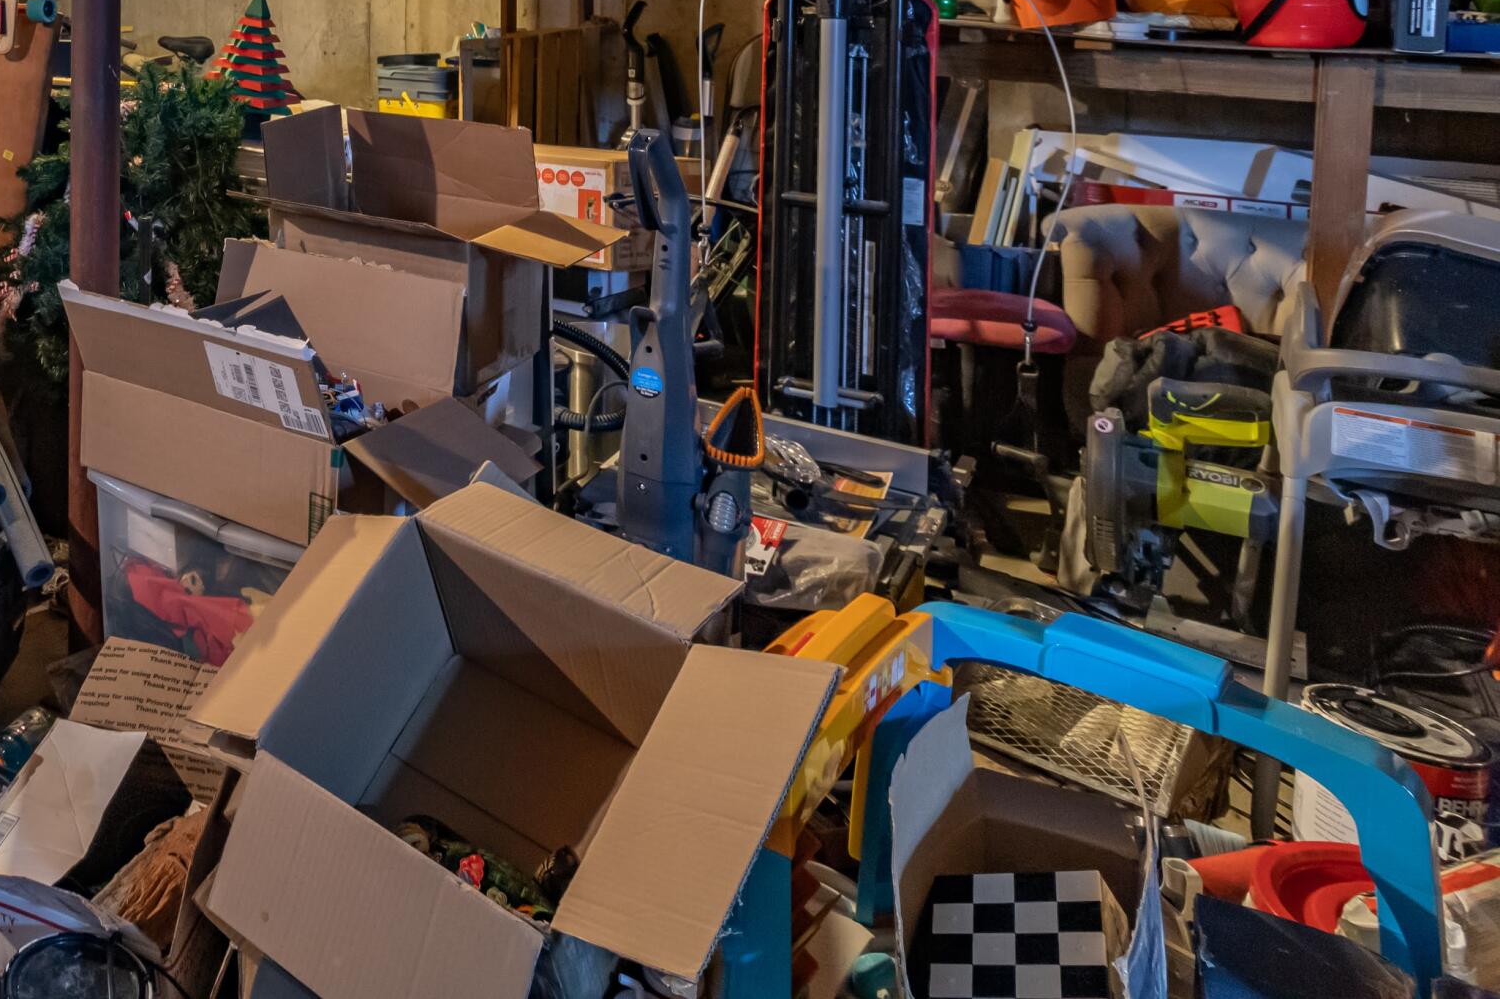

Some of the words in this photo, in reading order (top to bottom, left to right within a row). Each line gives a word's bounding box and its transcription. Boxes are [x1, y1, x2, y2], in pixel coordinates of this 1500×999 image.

[1188, 467, 1238, 486] RYOBI
[150, 656, 172, 665] Thank
[131, 671, 151, 679] using
[153, 673, 181, 684] Priority
[143, 680, 165, 690] Thank
[124, 695, 144, 704] using
[146, 698, 174, 709] Priority
[135, 705, 158, 715] Thank
[116, 721, 137, 729] using
[138, 723, 167, 734] Priority
